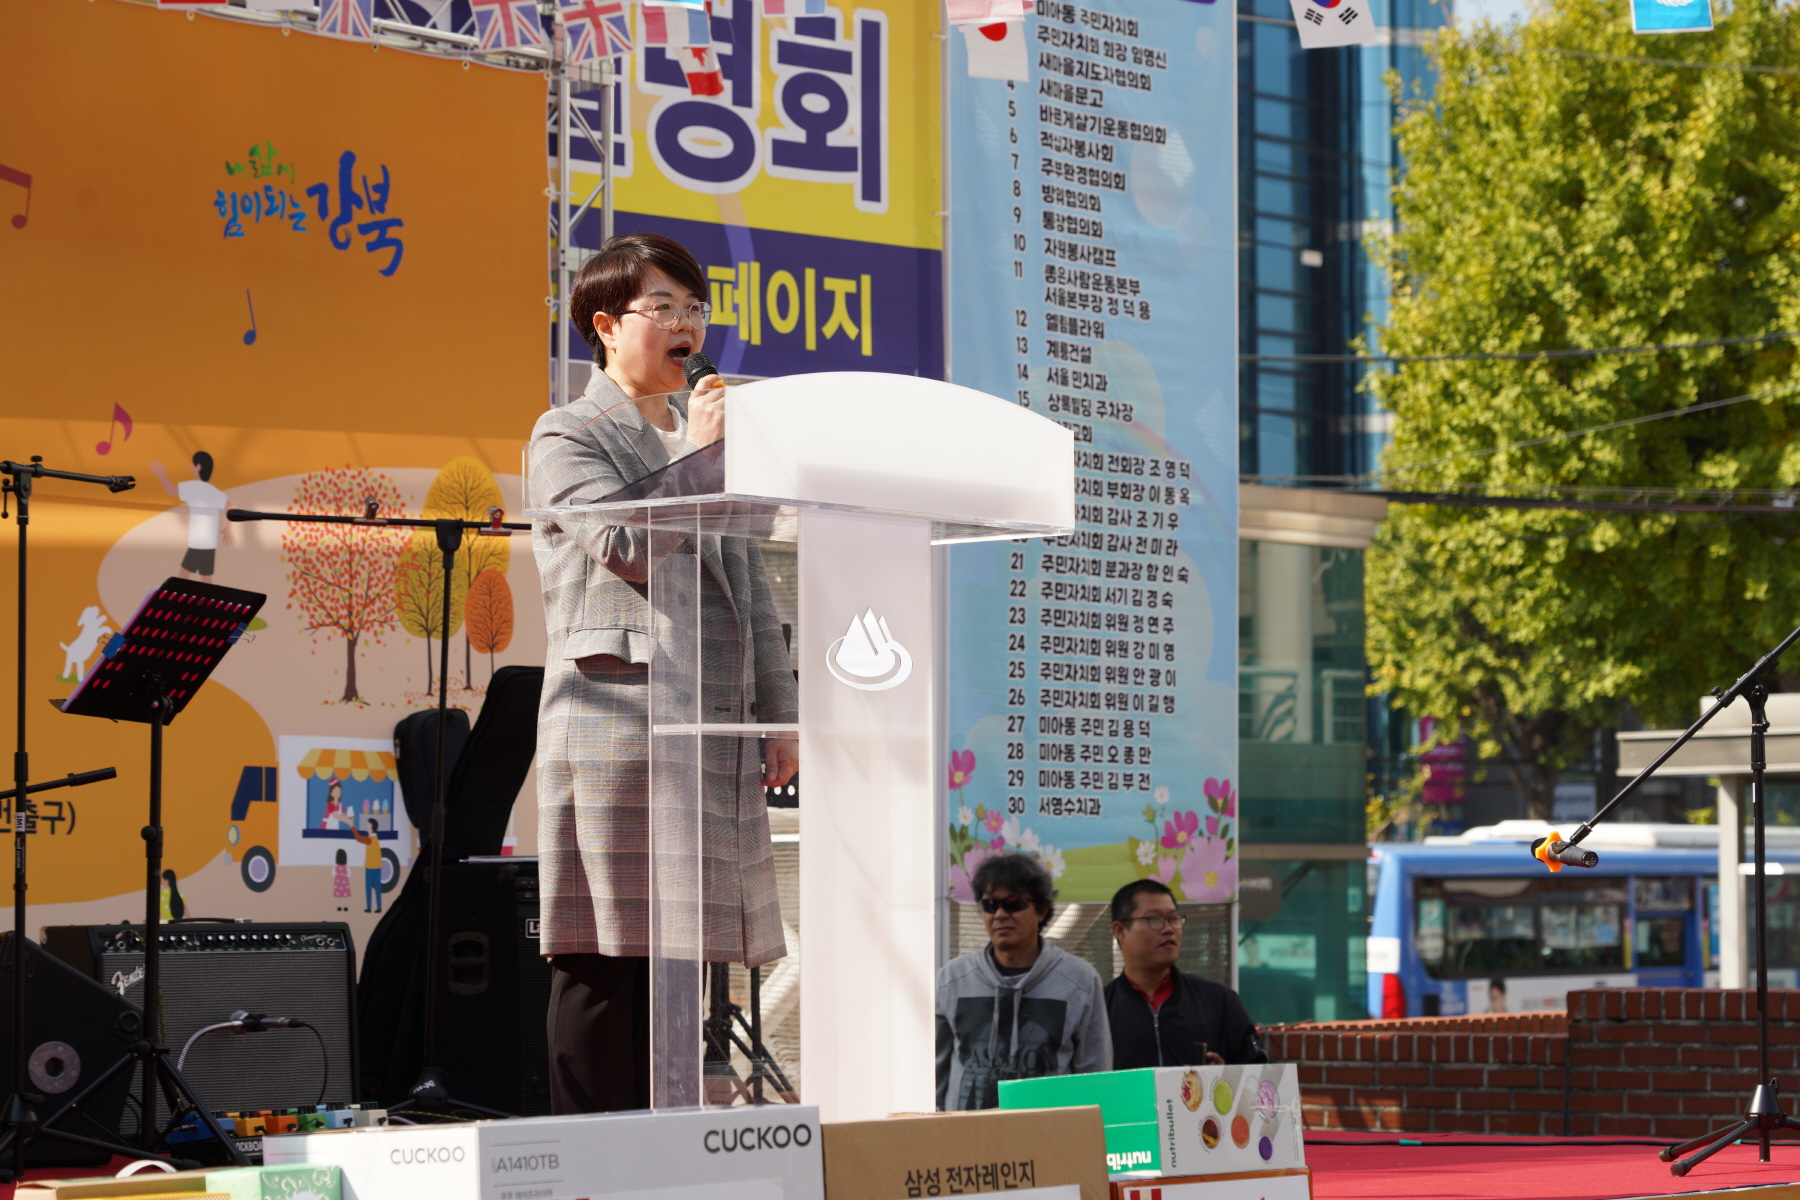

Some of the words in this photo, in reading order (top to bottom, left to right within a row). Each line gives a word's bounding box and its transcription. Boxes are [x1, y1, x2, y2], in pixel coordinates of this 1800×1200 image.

[1036, 0, 1075, 24] 미아동
[1080, 9, 1138, 38] 주민자치회
[1037, 25, 1100, 52] 주민자치회
[1104, 40, 1127, 62] 회장
[1039, 52, 1151, 91] 새마을지도자협의회
[1040, 79, 1103, 108] 새마을문고
[1008, 101, 1016, 117] 5
[1040, 105, 1166, 144] 바르게살기운동협의회
[1010, 128, 1017, 143] 6
[1040, 132, 1113, 163] 적십자봉사회
[1011, 154, 1018, 169] 7
[1041, 158, 1126, 191] 주부환경협의회
[1013, 181, 1021, 196] 8
[1042, 184, 1101, 212] 방위협의회
[306, 150, 404, 277] 강북
[1014, 207, 1021, 223] 9
[1043, 211, 1103, 238] 통장협의회
[1014, 235, 1026, 251] 10
[1044, 238, 1116, 267] 자원봉사캠프
[1015, 261, 1022, 278] 11
[699, 261, 873, 357] 페이지
[1045, 288, 1103, 313] 서울본부장
[1016, 310, 1027, 326] 12
[1017, 337, 1028, 353] 13
[1047, 340, 1092, 364] 계룡건설
[1017, 364, 1029, 380] 14
[1047, 367, 1069, 387] 서울
[1072, 370, 1108, 392] 민치과
[1018, 391, 1029, 407] 15
[1096, 400, 1133, 422] 주차장
[1108, 455, 1145, 476] 전회장
[1107, 481, 1145, 502] 부회장
[1107, 507, 1132, 527] 감사
[1107, 534, 1132, 553] 감사
[1011, 552, 1024, 570] 21
[1042, 554, 1101, 576] 주민자치회
[1106, 560, 1142, 581] 분과장
[1010, 580, 1026, 597] 22
[1041, 581, 1101, 603] 주민자치회
[1105, 587, 1128, 605] 서기
[1009, 607, 1025, 624] 23
[1040, 608, 1101, 630] 주민자치회
[1105, 613, 1128, 632] 위원
[1009, 634, 1025, 651] 24
[1040, 635, 1101, 657] 주민자치회
[1105, 639, 1128, 658] 위원
[1009, 661, 1025, 678] 25
[1040, 662, 1101, 683] 주민자치회
[1105, 666, 1128, 685] 위원
[1008, 688, 1025, 705] 26
[1040, 689, 1101, 710] 주민자치회
[1105, 692, 1128, 711] 위원
[1007, 716, 1025, 733] 27
[1039, 716, 1076, 736] 미아동
[1081, 718, 1103, 736] 주민
[1007, 743, 1024, 760] 28
[1039, 743, 1076, 763] 미아동
[1080, 745, 1103, 763] 주민
[1007, 770, 1024, 787] 29
[1039, 770, 1076, 789] 미아동
[1080, 771, 1103, 789] 주민
[1008, 797, 1025, 814] 30
[1038, 797, 1101, 816] 서영수치과
[111, 964, 147, 995] Fende
[704, 1123, 812, 1154] CUCKOO
[1168, 1098, 1177, 1168] nutribullet
[390, 1146, 465, 1165] CUCKOO
[496, 1154, 559, 1173] A1410TB
[904, 1168, 941, 1197] 삼성
[946, 1161, 1036, 1193] 전자레인지
